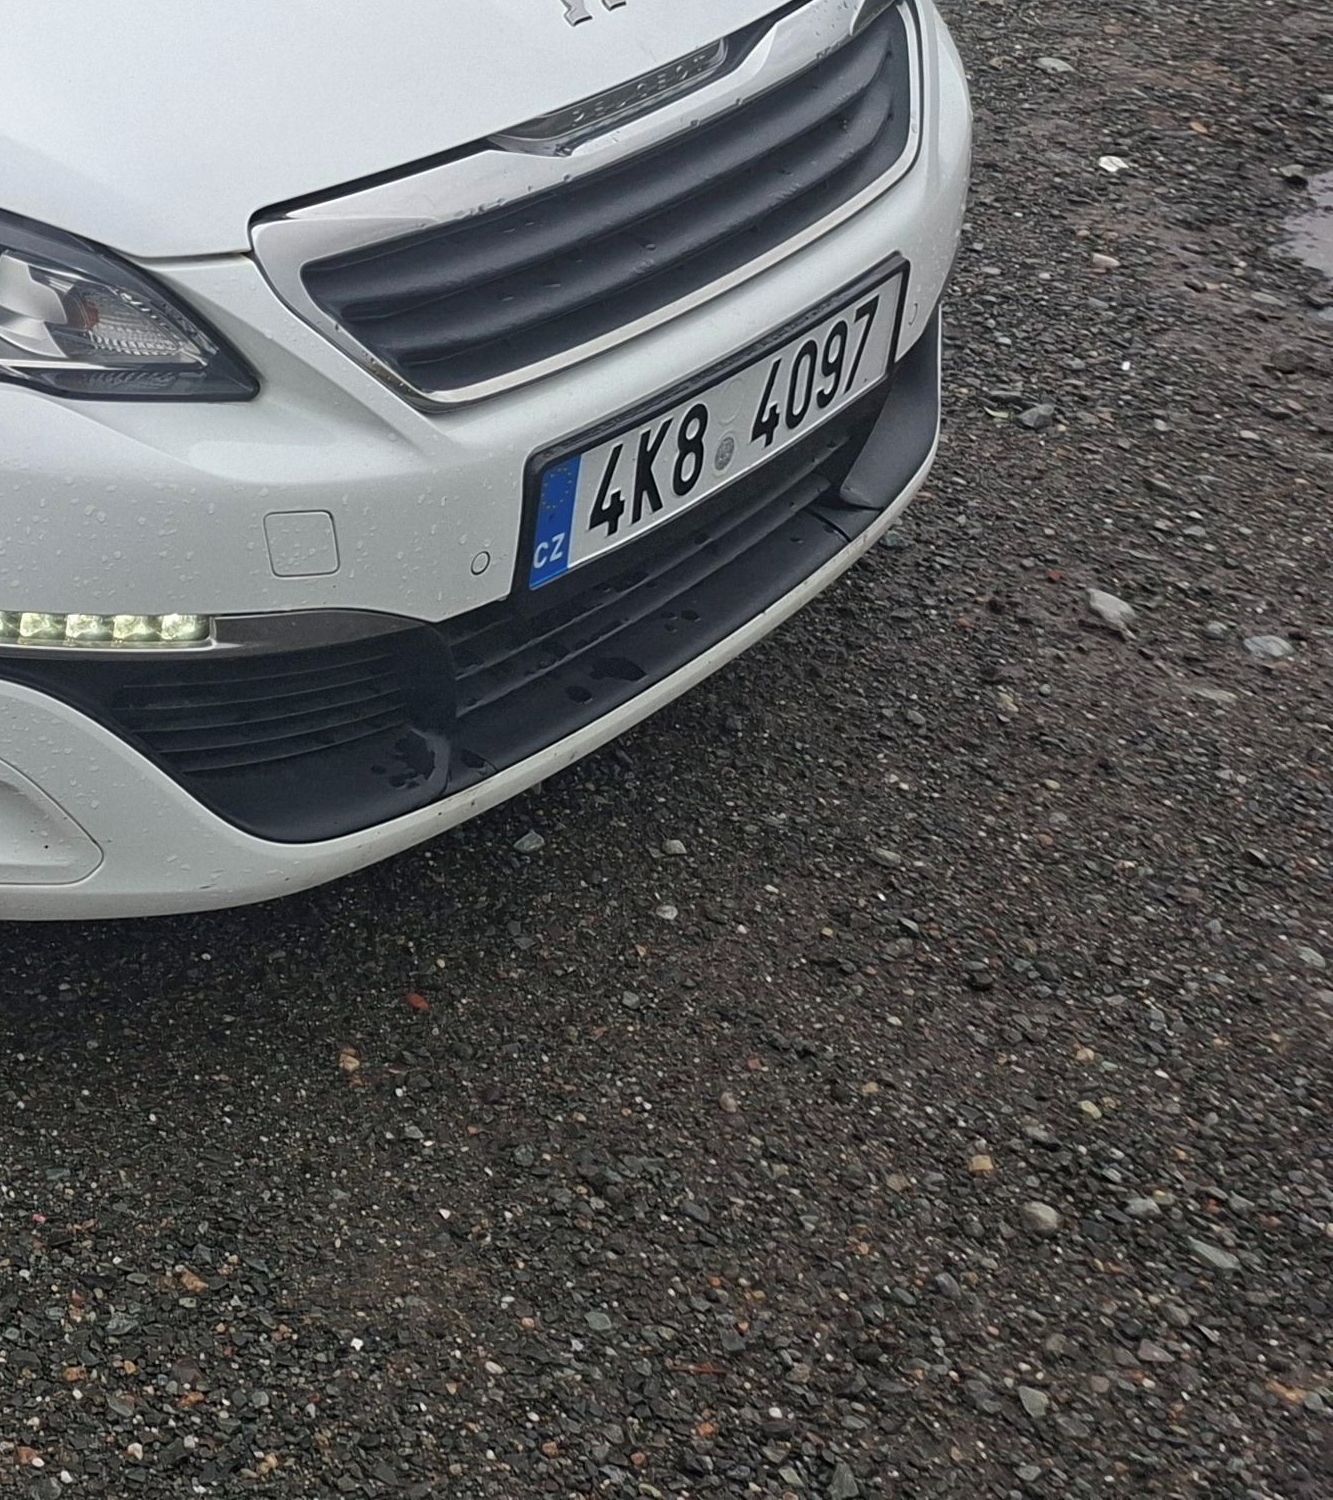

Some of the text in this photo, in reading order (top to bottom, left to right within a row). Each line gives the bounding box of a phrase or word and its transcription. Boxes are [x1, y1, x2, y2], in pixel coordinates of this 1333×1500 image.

[588, 293, 881, 537] 4K8 4097
[533, 531, 565, 570] CZ
